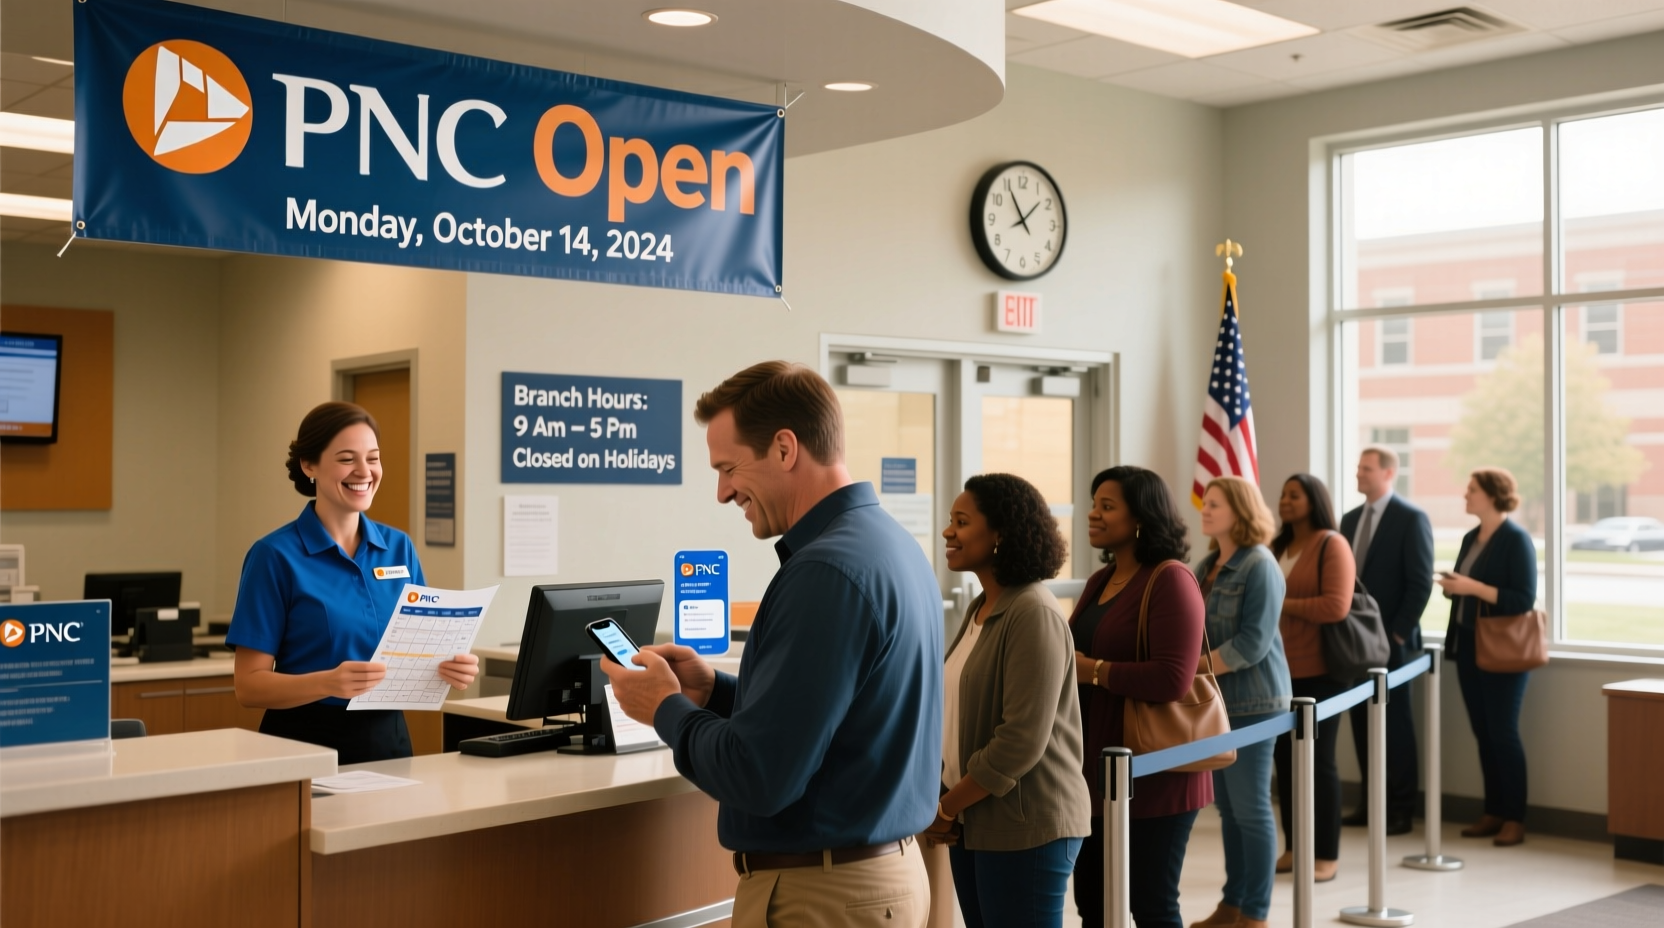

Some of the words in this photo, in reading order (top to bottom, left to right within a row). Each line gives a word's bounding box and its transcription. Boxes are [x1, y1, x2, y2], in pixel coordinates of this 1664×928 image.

[272, 73, 508, 189] PNC
[533, 104, 756, 223] Open
[1018, 176, 1028, 190] 12
[992, 193, 1002, 206] 10
[1045, 198, 1052, 210] 2
[988, 213, 996, 226] 9
[1049, 220, 1056, 232] 3
[285, 197, 423, 248] Monday,
[433, 211, 552, 252] October
[559, 224, 599, 262] 14,
[606, 229, 674, 262] 2024
[995, 234, 1001, 246] 8
[1004, 249, 1011, 264] 7
[1019, 256, 1026, 268] 6
[514, 385, 583, 408] Branch
[588, 387, 648, 410] Hours:
[513, 415, 529, 437] 9
[532, 416, 566, 438] Am
[590, 417, 603, 438] 5
[606, 417, 637, 439] Pm
[512, 447, 574, 468] Closed
[577, 453, 600, 468] on
[604, 449, 676, 474] Holidays
[695, 563, 720, 576] PNC
